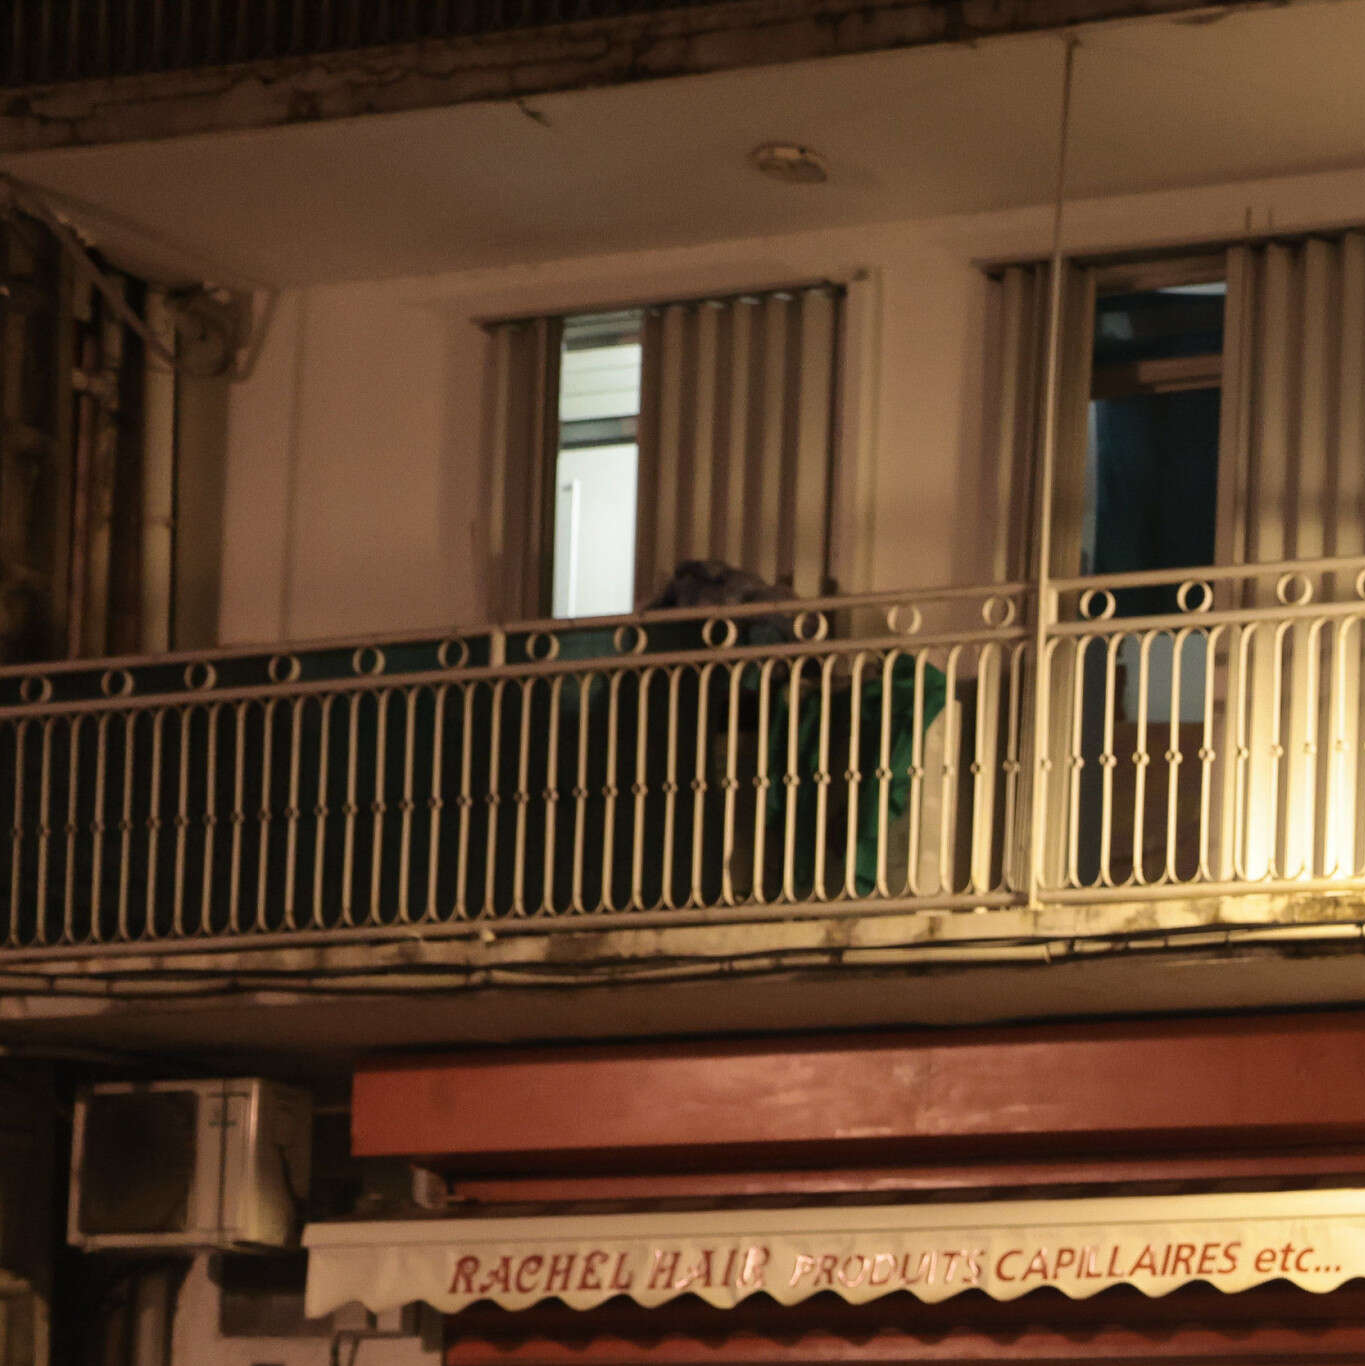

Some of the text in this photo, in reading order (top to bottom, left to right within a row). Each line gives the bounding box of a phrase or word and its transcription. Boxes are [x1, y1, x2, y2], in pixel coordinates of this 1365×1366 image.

[448, 1241, 1342, 1294] RACHEL HAIR PRODUITS CAPILLAIRES etc...
